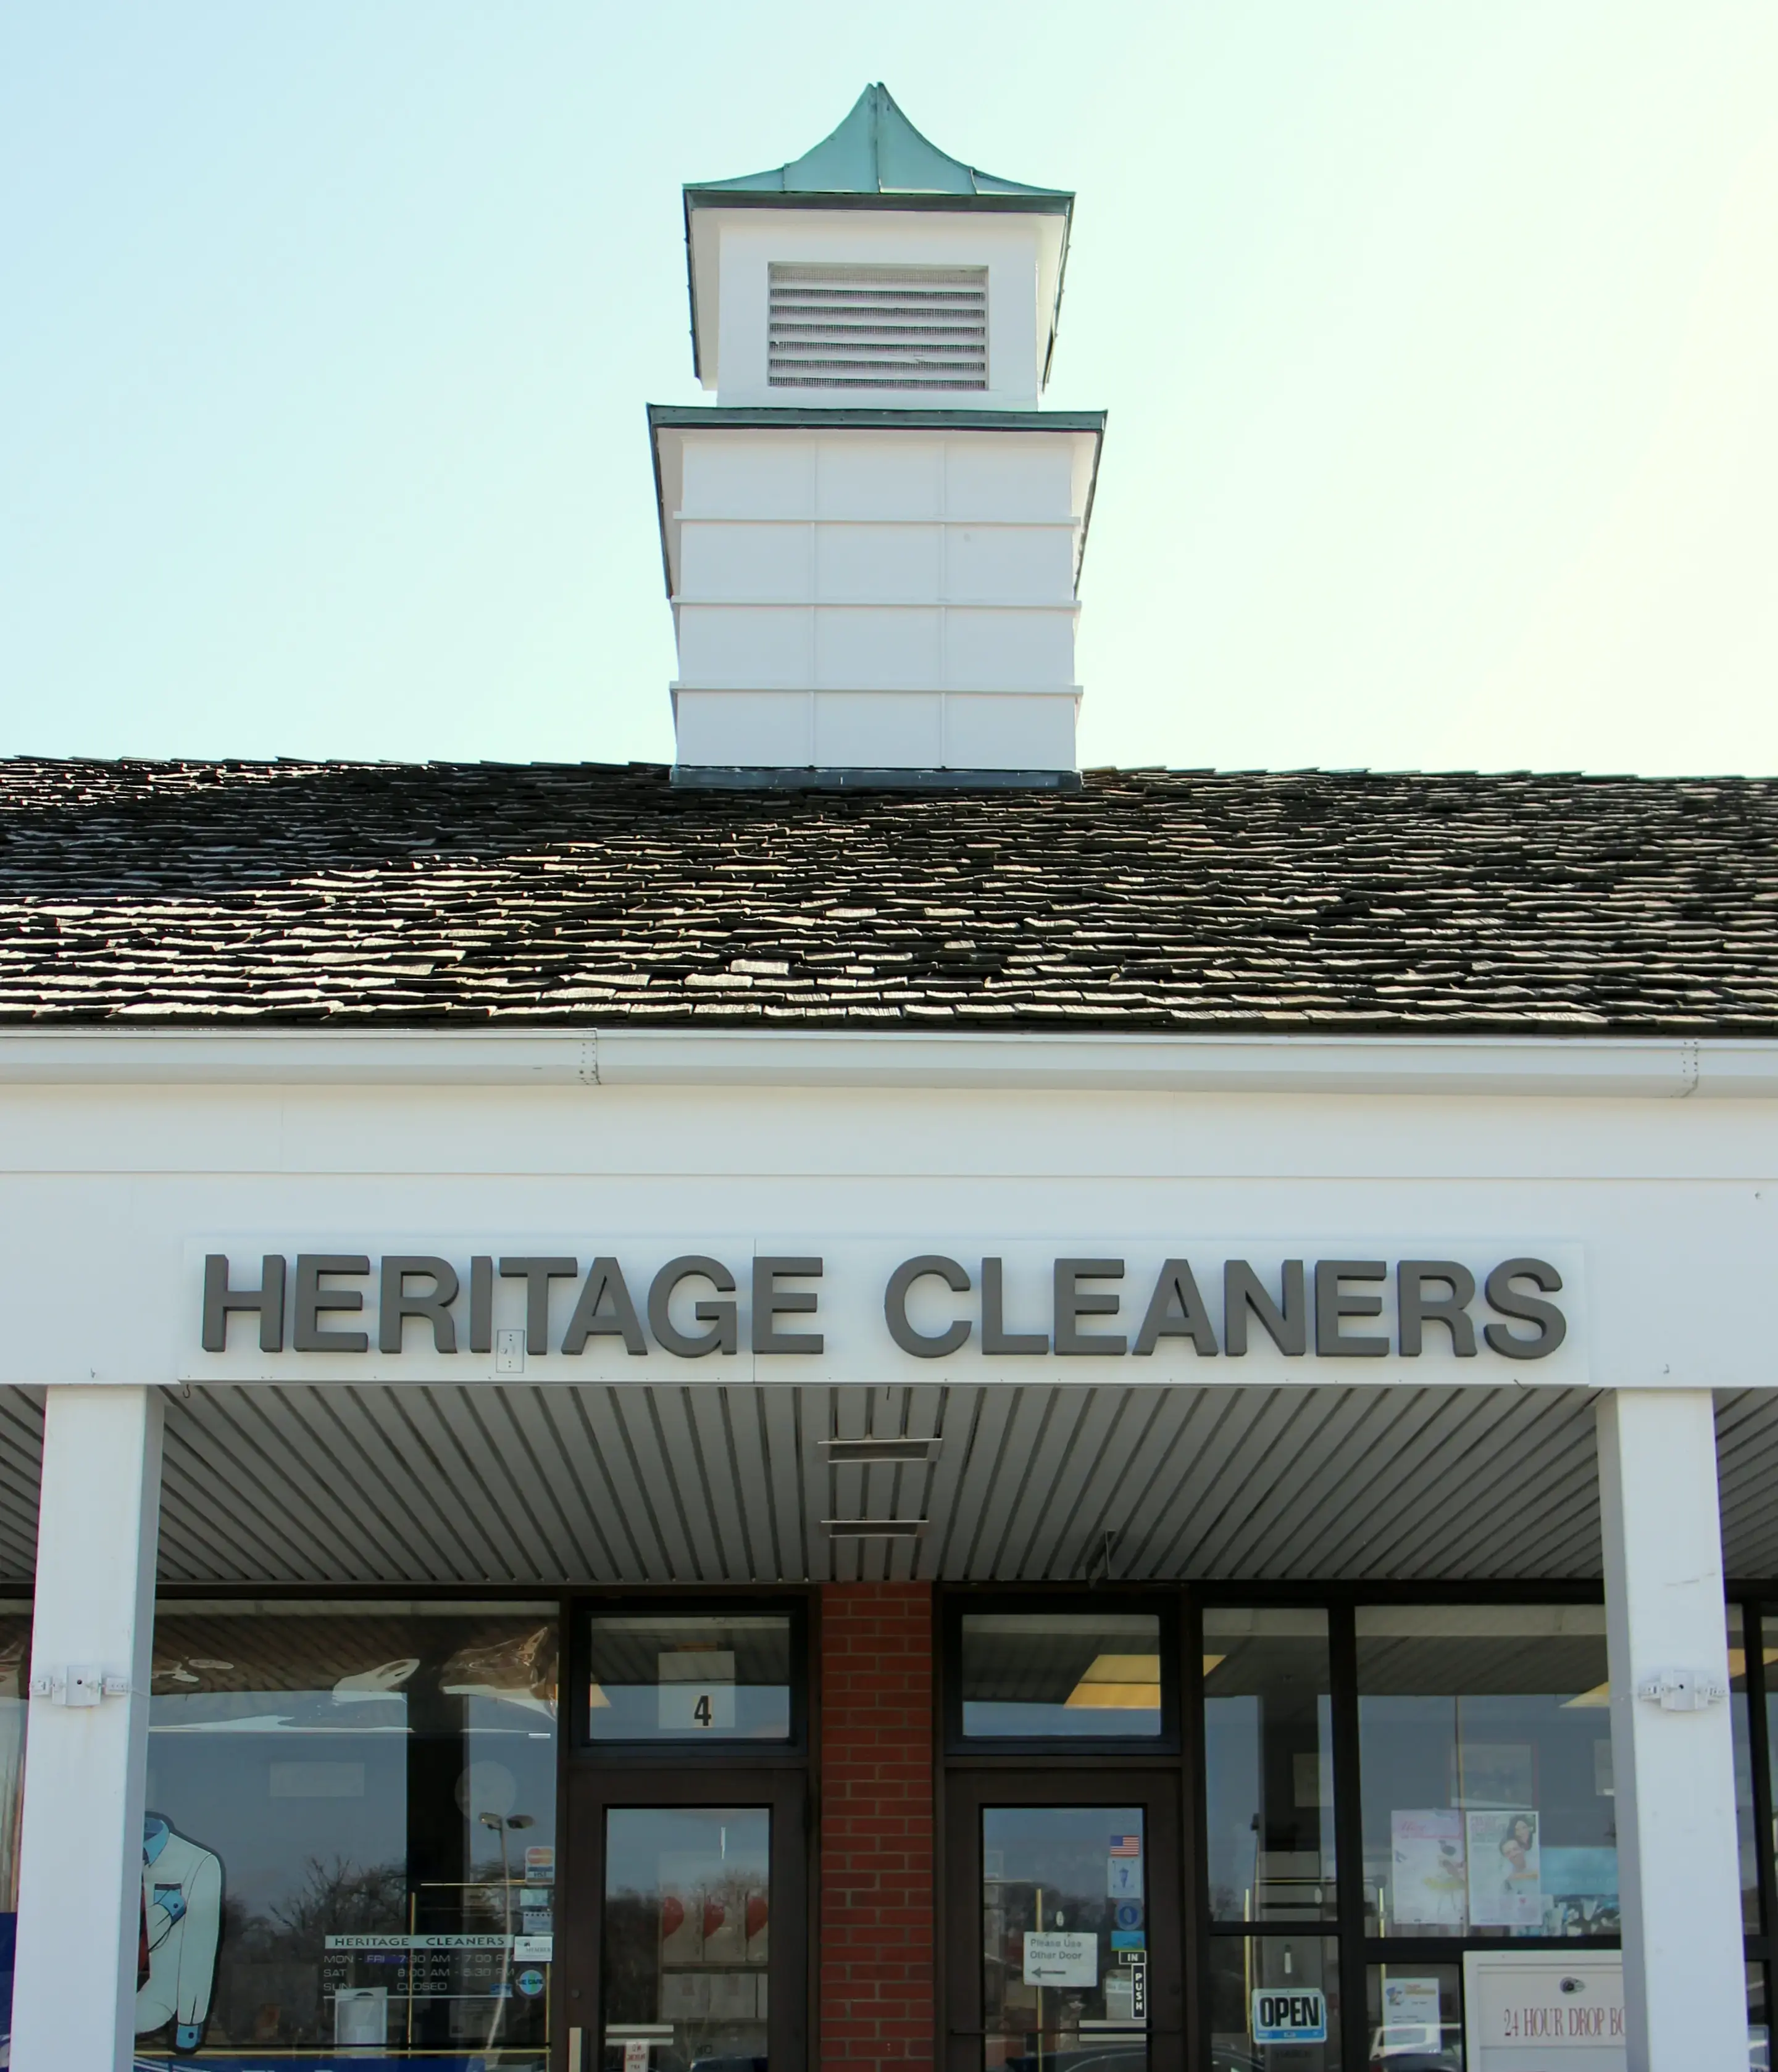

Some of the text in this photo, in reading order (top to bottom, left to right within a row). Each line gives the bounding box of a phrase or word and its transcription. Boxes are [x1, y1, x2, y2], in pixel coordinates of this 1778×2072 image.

[202, 1254, 1566, 1358] HERITAGE CLEANERS
[694, 1695, 712, 1726] 4
[335, 1937, 504, 1945] HERITAGE CLEANERS
[1030, 1939, 1082, 1947] Please Use
[323, 1955, 353, 1963] MON
[366, 1955, 385, 1963] FRI
[431, 1955, 450, 1963] AM
[1030, 1950, 1082, 1960] Other Door
[1127, 1953, 1138, 1962] IN
[323, 1969, 346, 1977] SAT
[430, 1969, 450, 1977] AM
[496, 1968, 514, 1976] PM
[323, 1983, 447, 1991] SUN CLOSED
[1260, 1997, 1319, 2027] OPEN
[1504, 2007, 1625, 2037] 24 HOUR DROP BO
